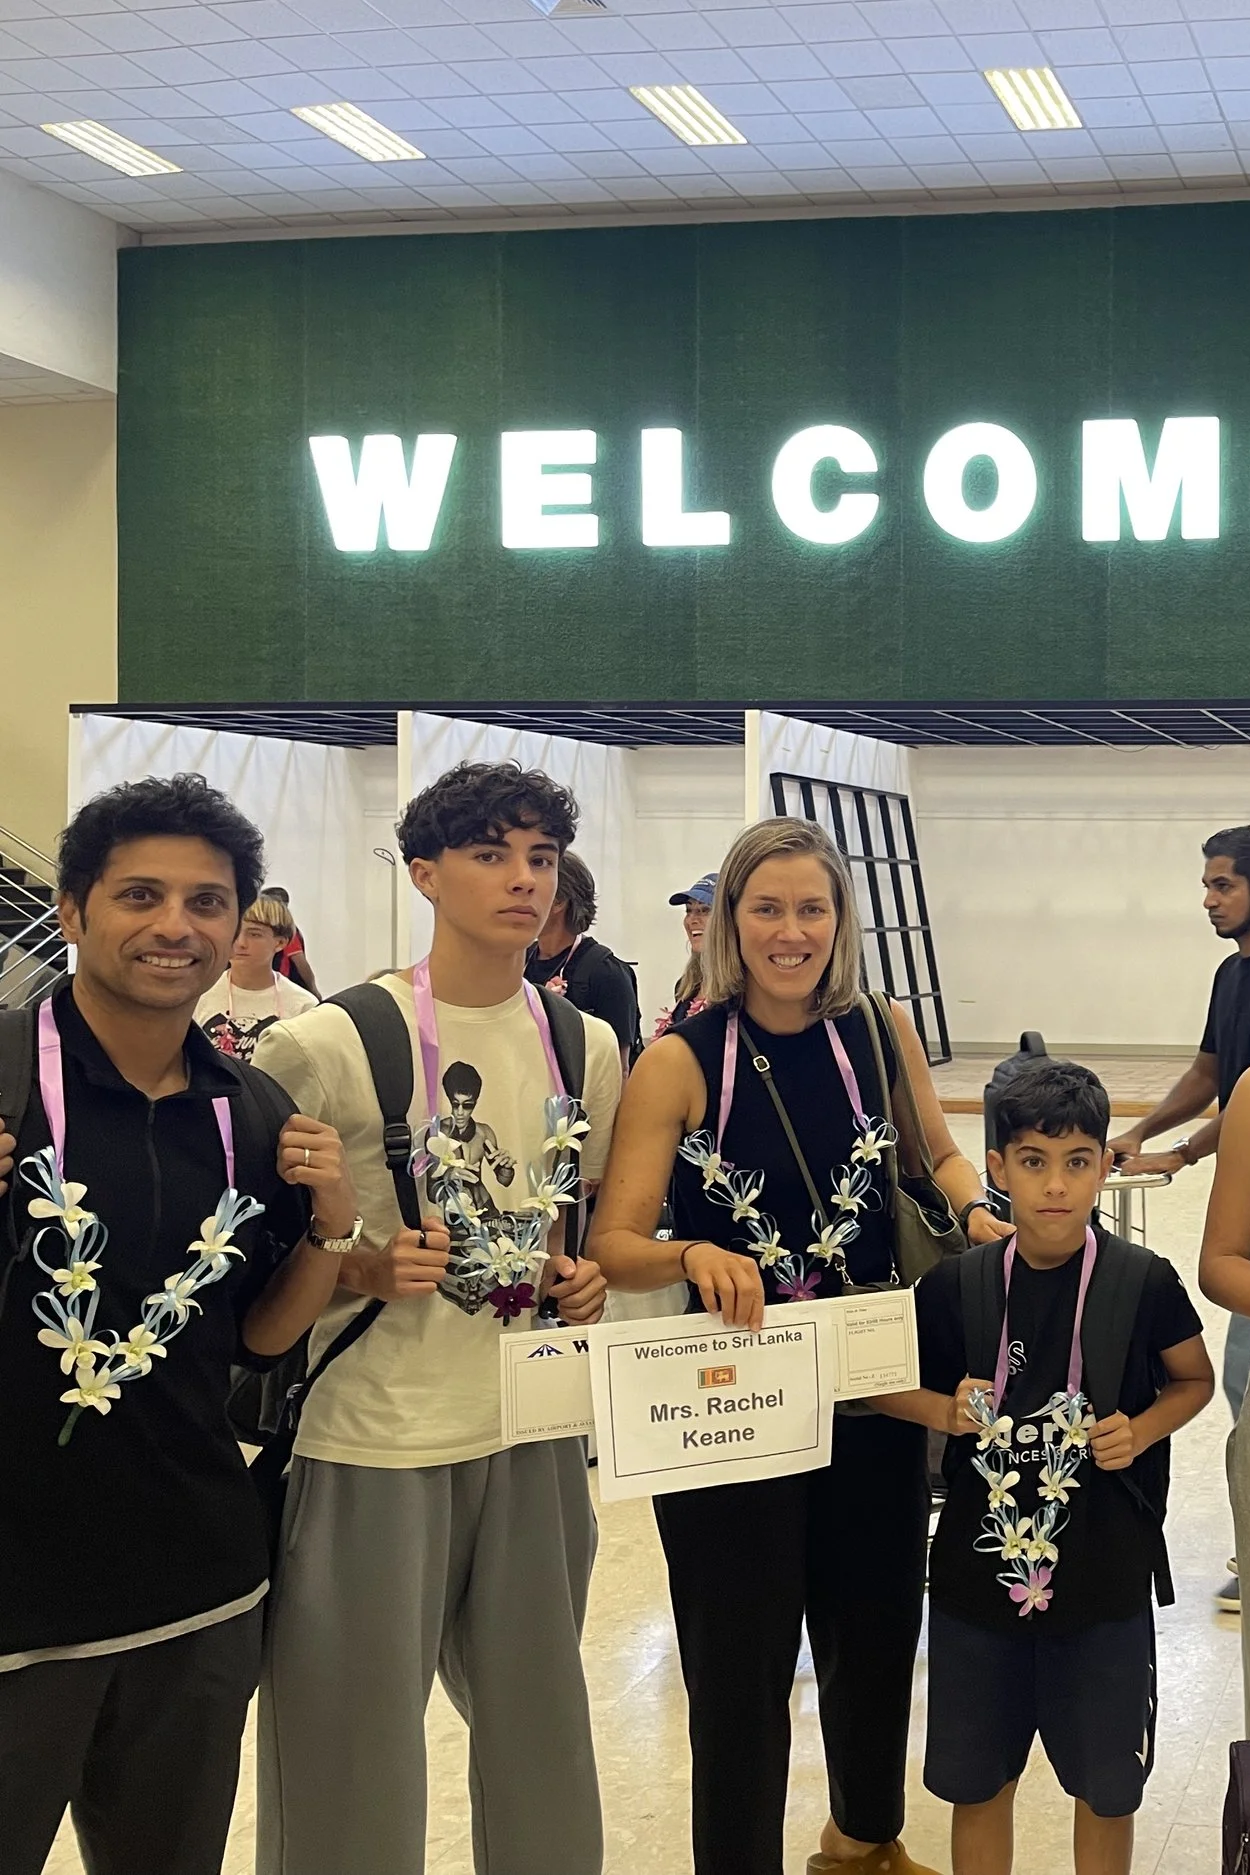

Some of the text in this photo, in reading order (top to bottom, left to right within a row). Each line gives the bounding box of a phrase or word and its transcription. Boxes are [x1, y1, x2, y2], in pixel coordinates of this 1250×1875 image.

[572, 1340, 589, 1353] W
[634, 1330, 803, 1360] Welcome to Sri Lanka
[650, 1388, 784, 1423] Mrs. Rachel
[682, 1427, 755, 1449] Keane
[1008, 1449, 1048, 1465] NCES
